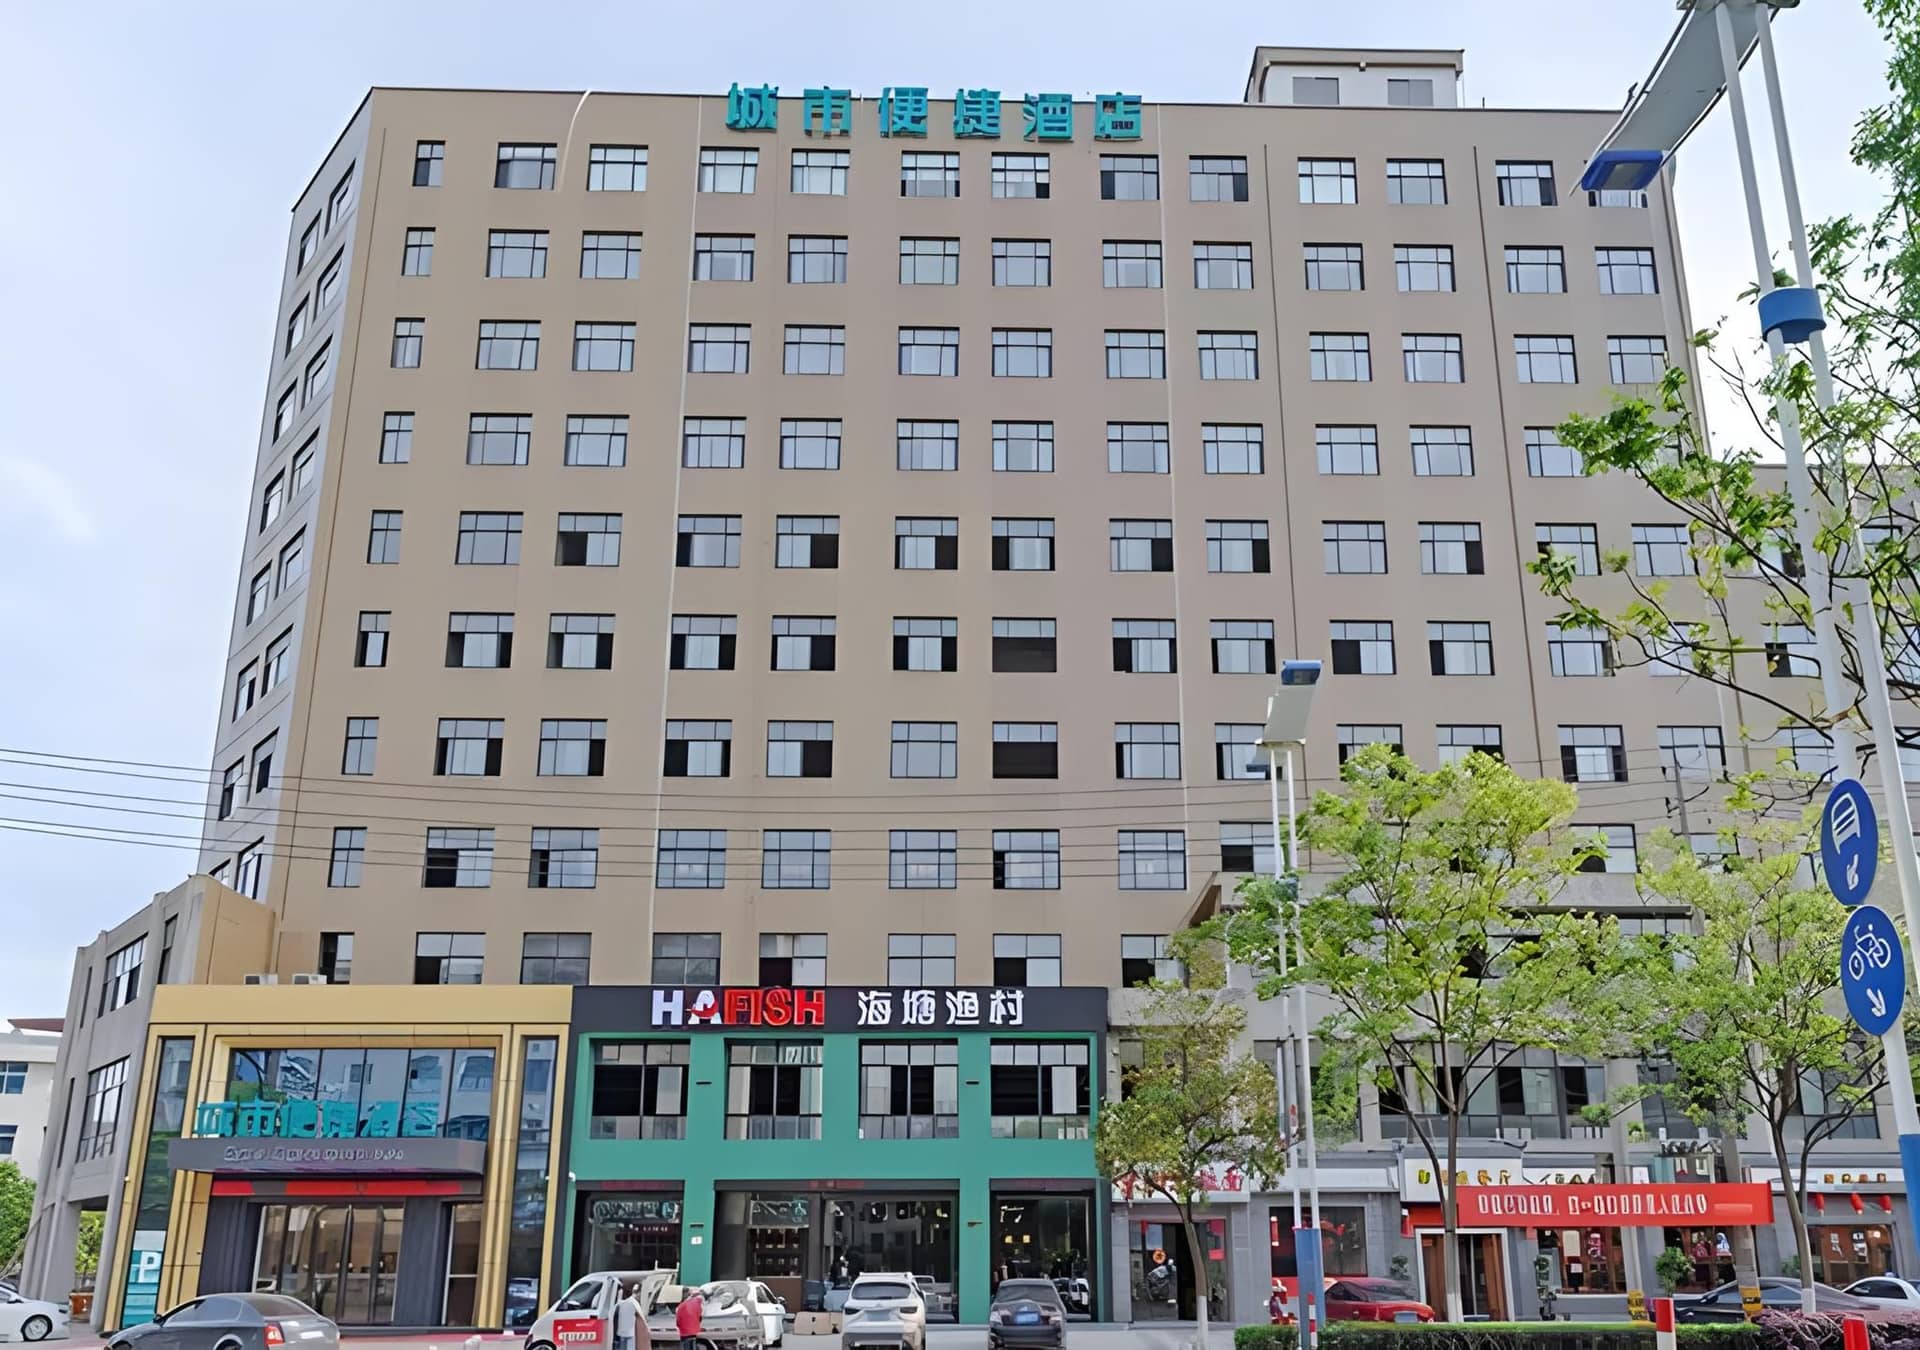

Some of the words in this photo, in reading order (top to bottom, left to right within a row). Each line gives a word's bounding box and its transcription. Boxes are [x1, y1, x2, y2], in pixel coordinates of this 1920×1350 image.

[726, 82, 1142, 141] 城市便捷酒店
